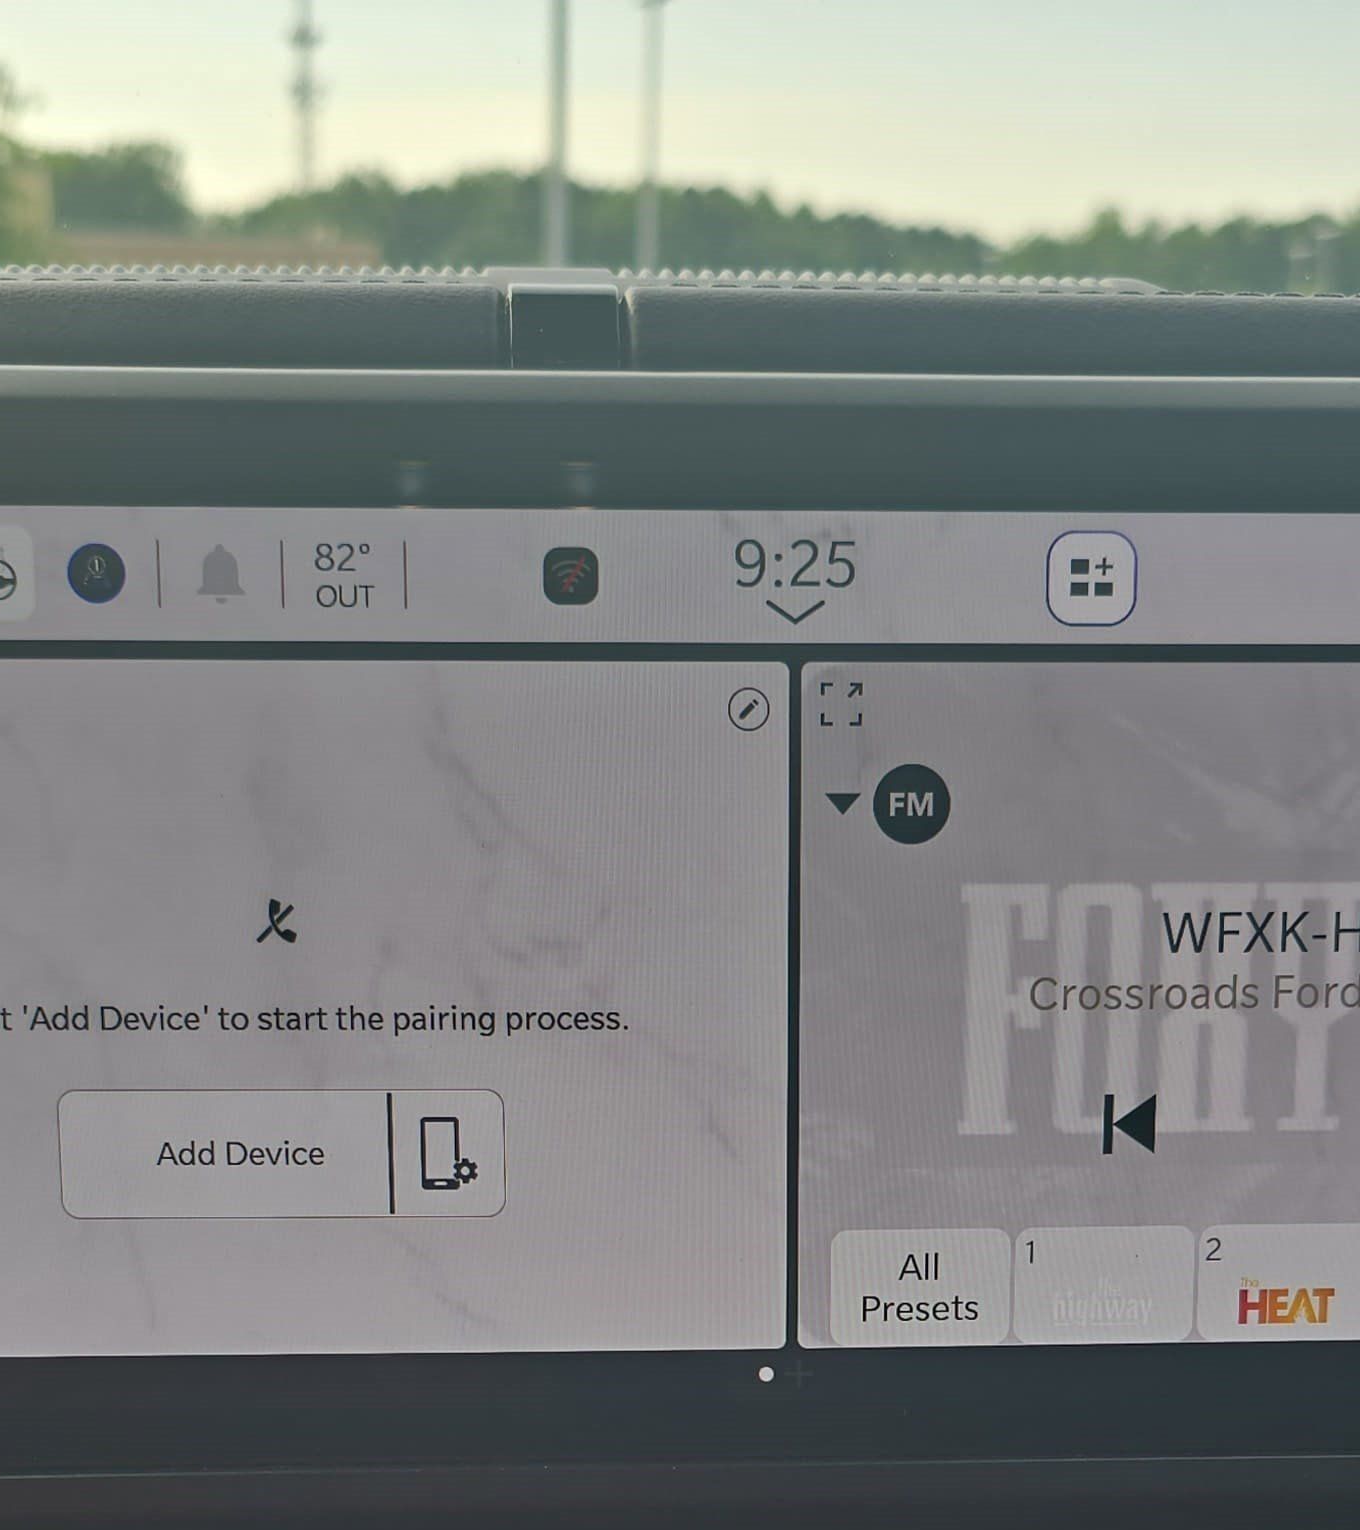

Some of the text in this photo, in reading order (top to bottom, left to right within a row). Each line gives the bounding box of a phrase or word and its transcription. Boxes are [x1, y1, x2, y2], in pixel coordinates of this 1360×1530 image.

[313, 542, 371, 573] 82°
[734, 538, 857, 589] 9:25
[315, 584, 375, 609] OUT
[888, 791, 934, 817] FM
[1029, 973, 1260, 1011] Crossroads
[22, 1004, 90, 1032] 'Add
[100, 1004, 209, 1031] Device'
[219, 1007, 249, 1031] to
[257, 1008, 329, 1031] start
[336, 1005, 384, 1031] the
[393, 1005, 496, 1037] pairing
[506, 1010, 630, 1037] process.
[155, 1140, 326, 1167] Add Device
[1024, 1239, 1036, 1265] 1
[1204, 1237, 1223, 1262] 2
[898, 1251, 940, 1281] All
[861, 1295, 980, 1323] Presets
[1237, 1287, 1336, 1325] HEAT
